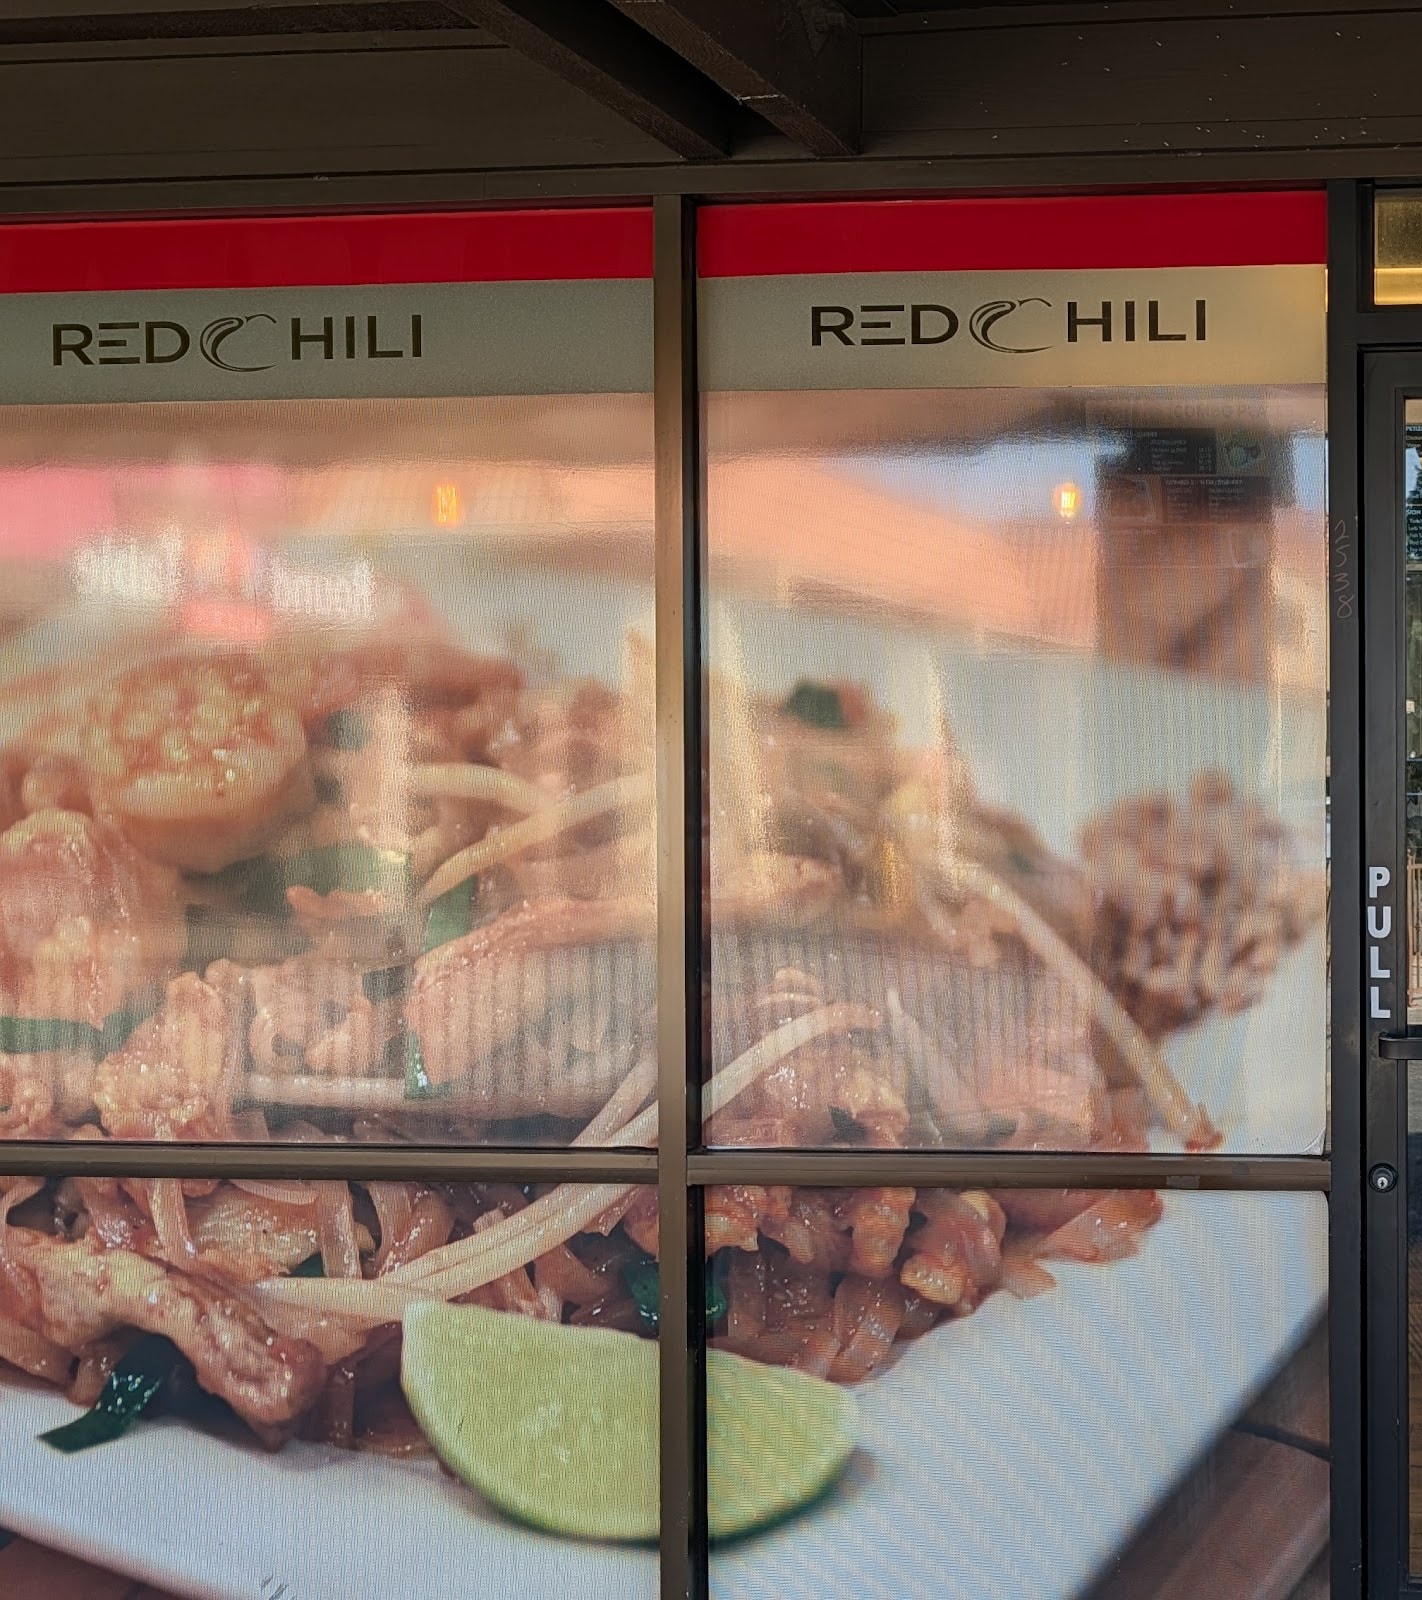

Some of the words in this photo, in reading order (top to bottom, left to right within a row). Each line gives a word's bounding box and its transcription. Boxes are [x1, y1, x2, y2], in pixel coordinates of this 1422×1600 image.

[52, 321, 190, 365] RED
[811, 304, 959, 346] RED
[1367, 867, 1392, 1018] PULL
